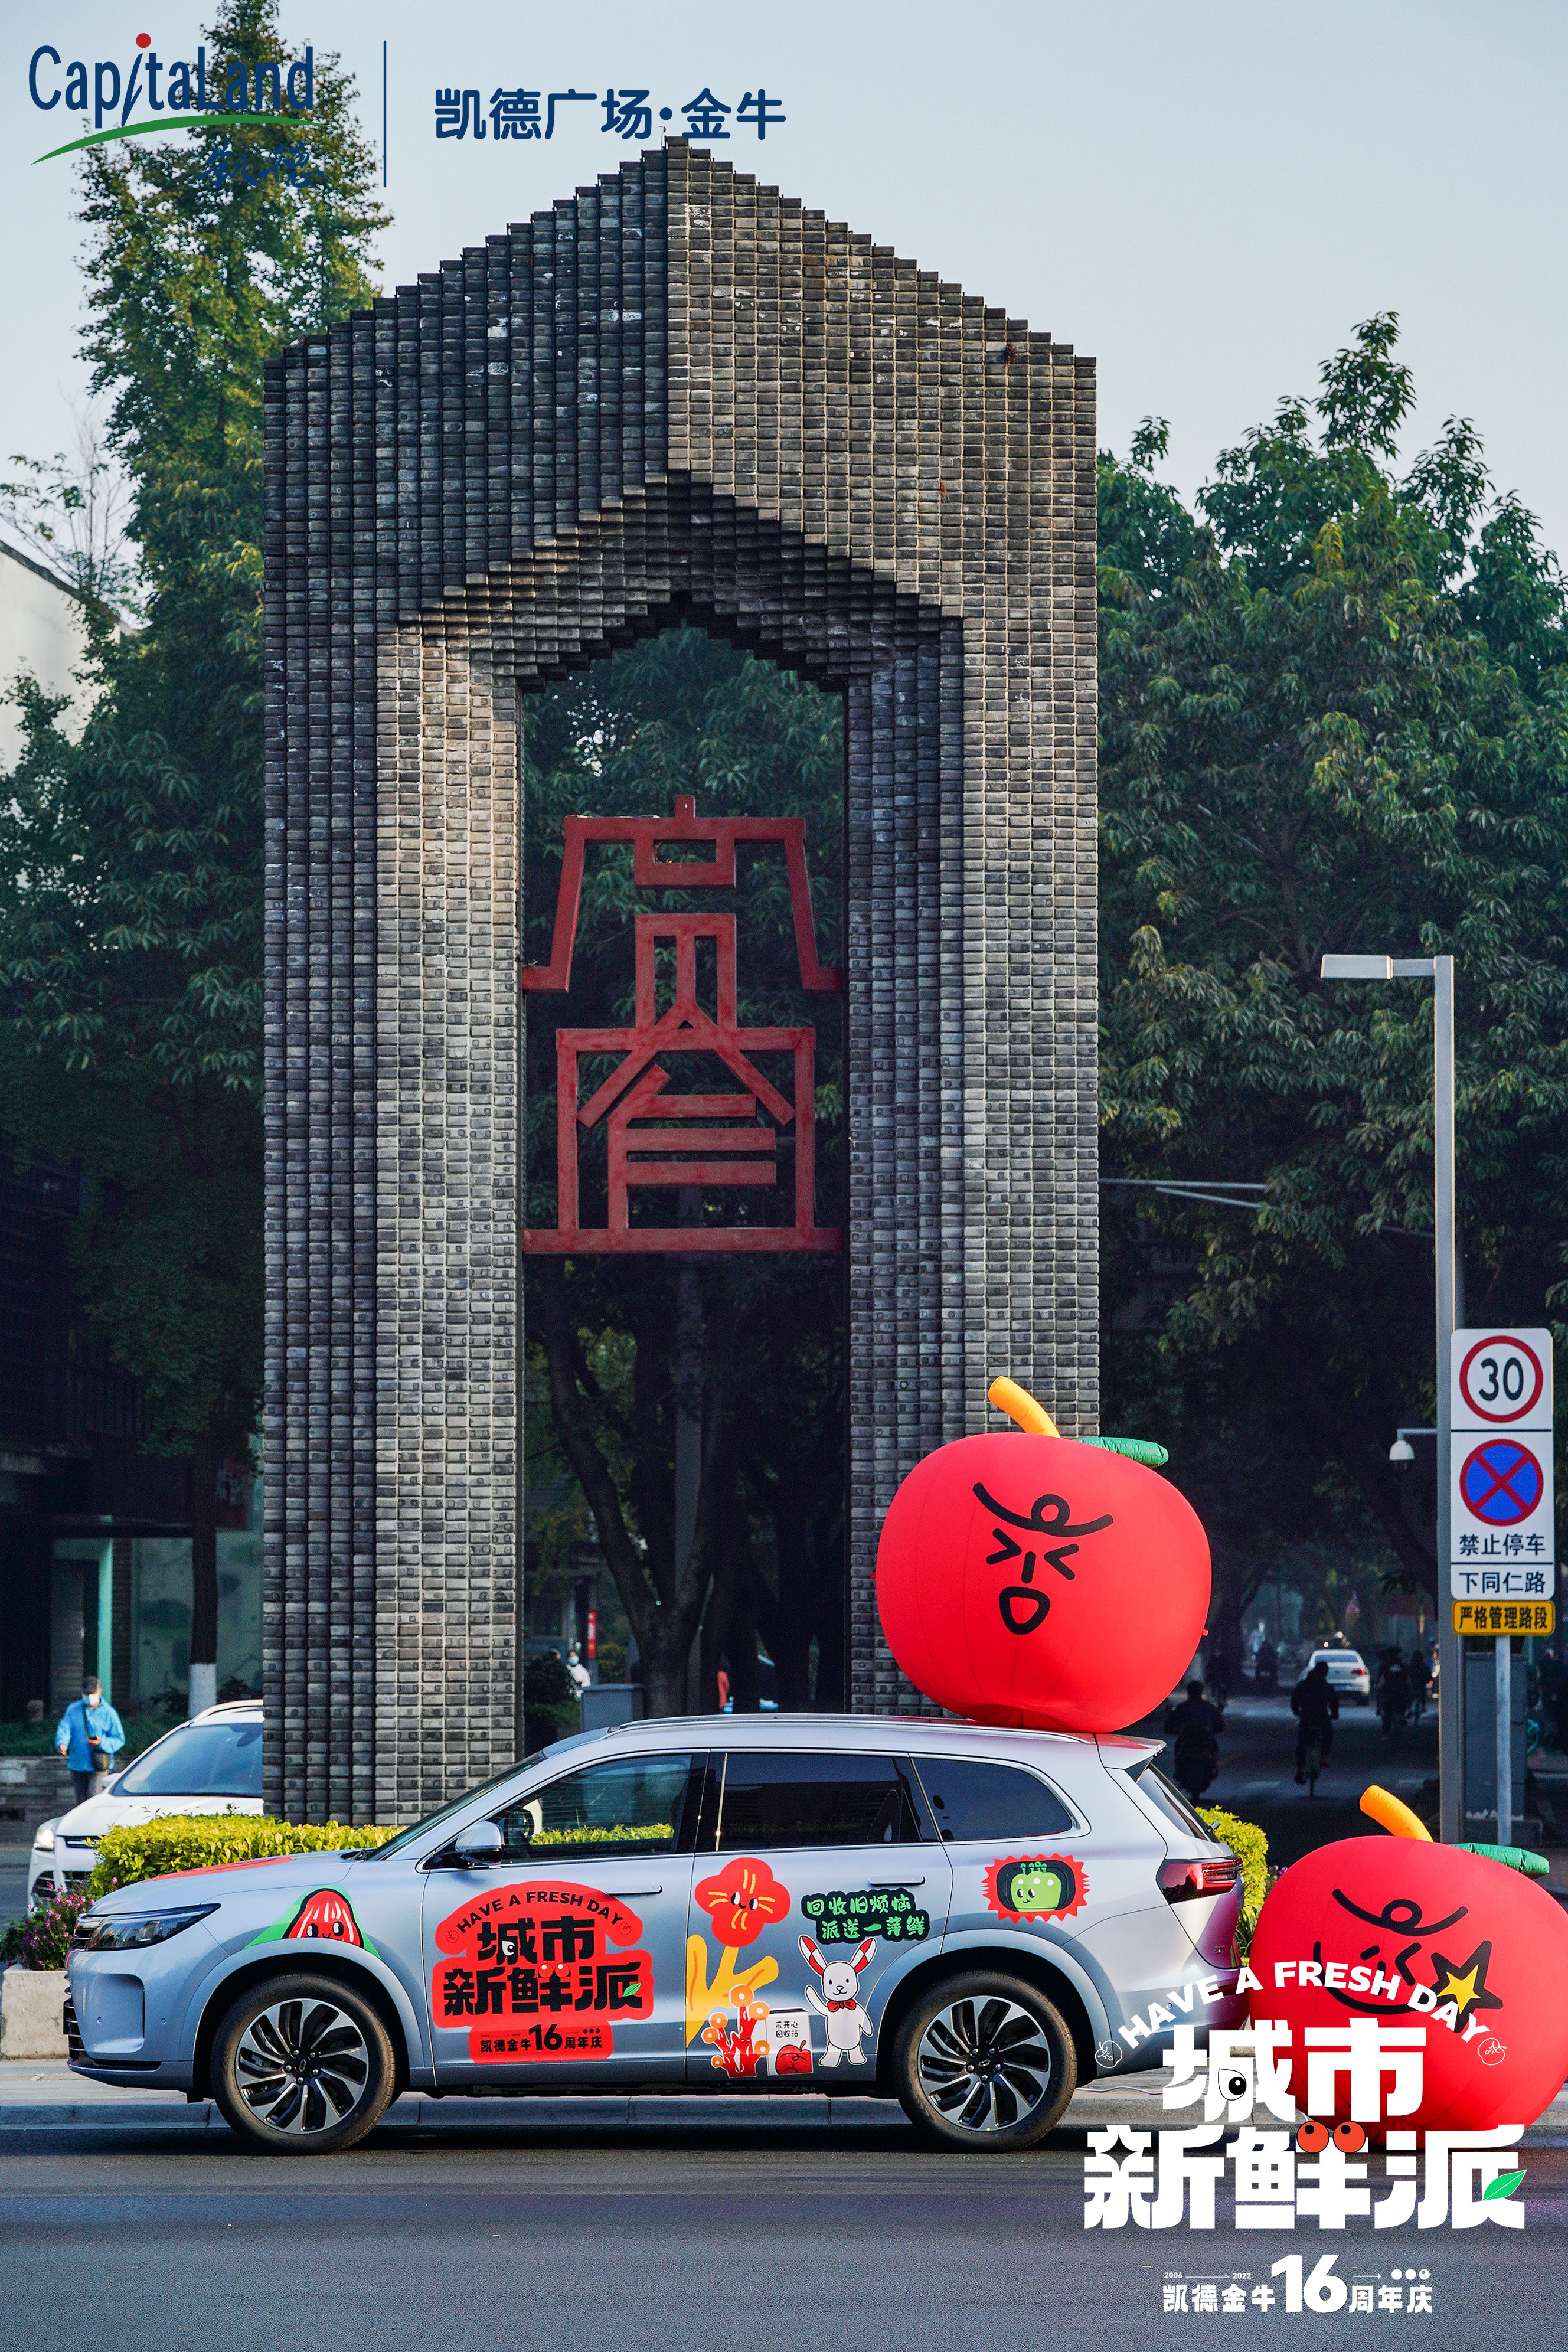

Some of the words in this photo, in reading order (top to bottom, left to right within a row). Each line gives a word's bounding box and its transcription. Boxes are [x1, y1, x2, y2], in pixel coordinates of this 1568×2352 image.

[1478, 1357, 1524, 1401] 30
[1459, 1533, 1546, 1556] 禁止停车
[1459, 1571, 1546, 1593] 下同仁路
[1459, 1605, 1548, 1630] 严格管理路段
[457, 1899, 504, 1933] HAVE
[509, 1894, 521, 1907] A
[526, 1891, 583, 1907] FRESH
[587, 1899, 623, 1925] DAY
[806, 1893, 912, 1916] 回收旧烦恼
[477, 1916, 596, 1965] 城市
[444, 1961, 643, 2016] 新鲜派
[776, 2021, 798, 2029] 不开心
